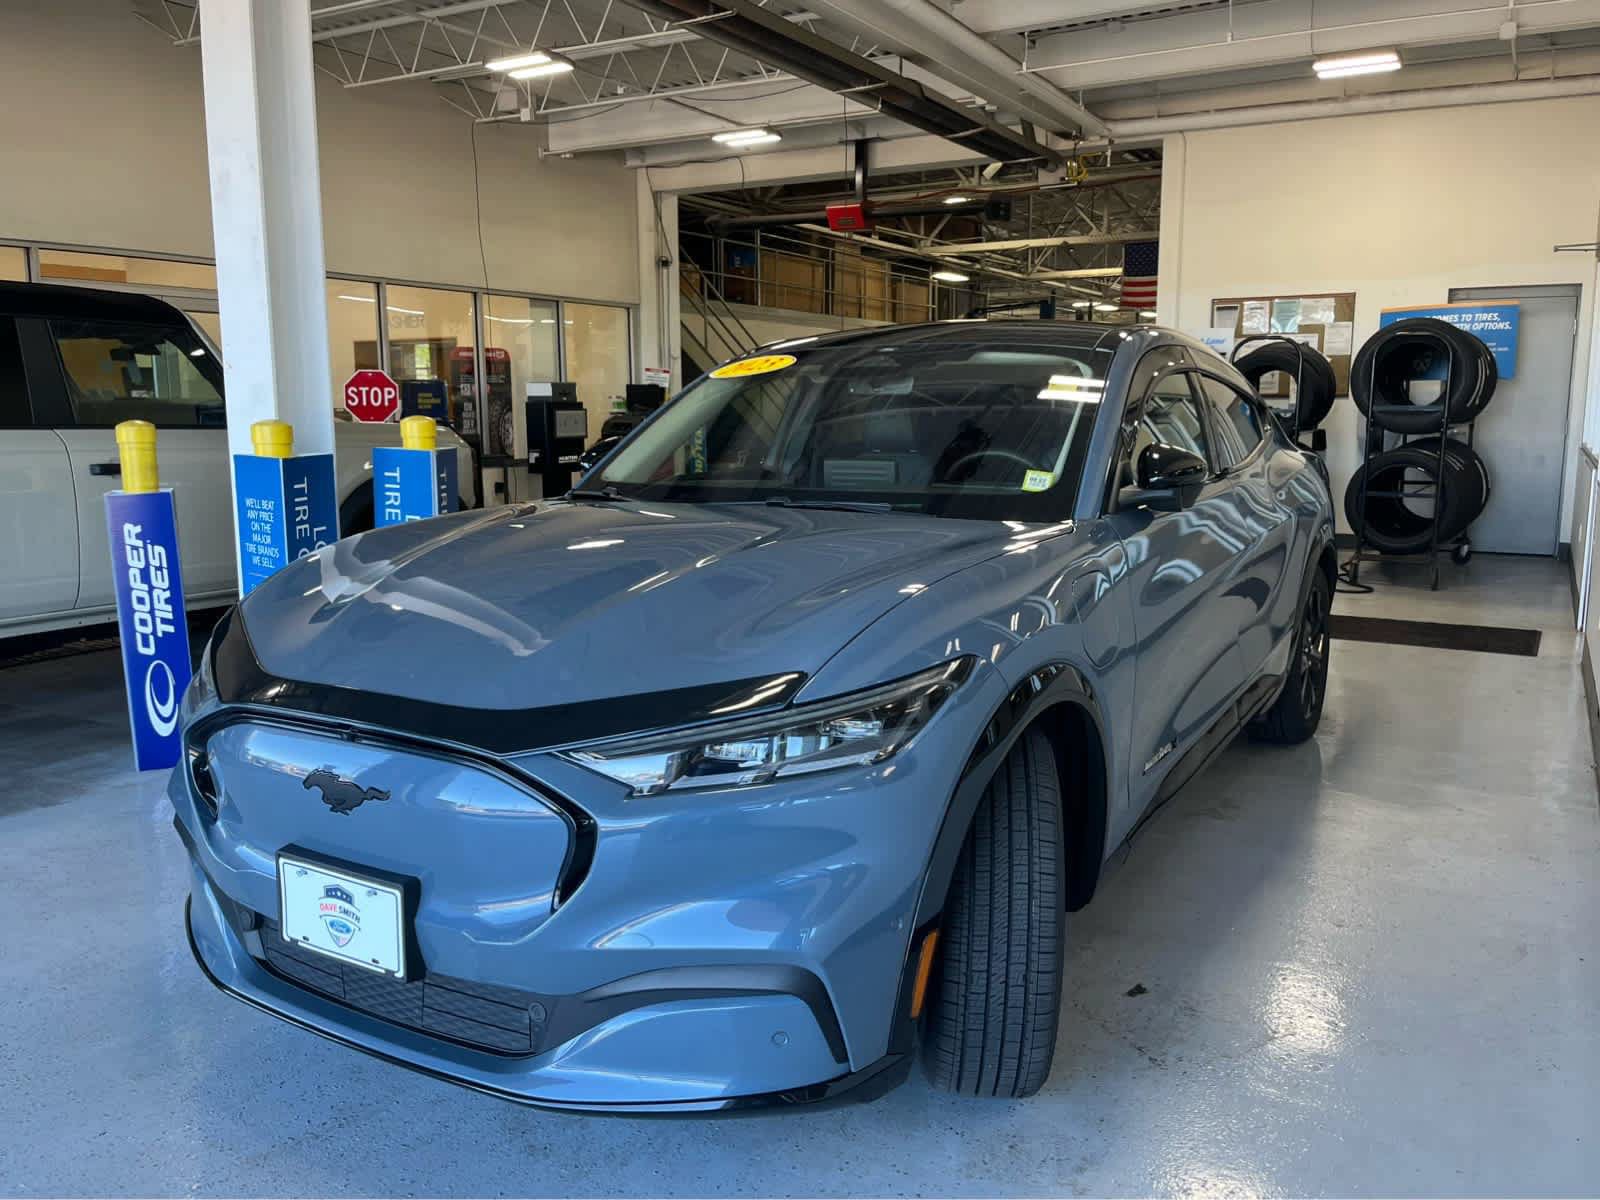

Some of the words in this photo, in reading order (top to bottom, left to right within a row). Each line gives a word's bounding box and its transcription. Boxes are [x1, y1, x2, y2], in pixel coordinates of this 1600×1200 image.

[1461, 312, 1473, 322] TO
[1474, 312, 1501, 322] TIRES,
[1472, 321, 1513, 331] OPTIONS.
[347, 386, 396, 407] STOP
[384, 466, 402, 521] TIRE
[261, 500, 275, 511] BEAT
[293, 476, 310, 540] TIRE
[247, 509, 259, 520] ANY
[259, 511, 274, 523] PRICE
[250, 521, 261, 532] ON
[261, 522, 272, 534] THE
[252, 532, 272, 545] MAJOR
[244, 542, 257, 555] TIRE
[257, 545, 280, 559] BRANDS
[252, 556, 261, 568] WE
[124, 523, 155, 654] COOPER
[147, 545, 175, 636] TIRES
[320, 903, 337, 912] DAVE
[338, 905, 360, 923] SMITH
